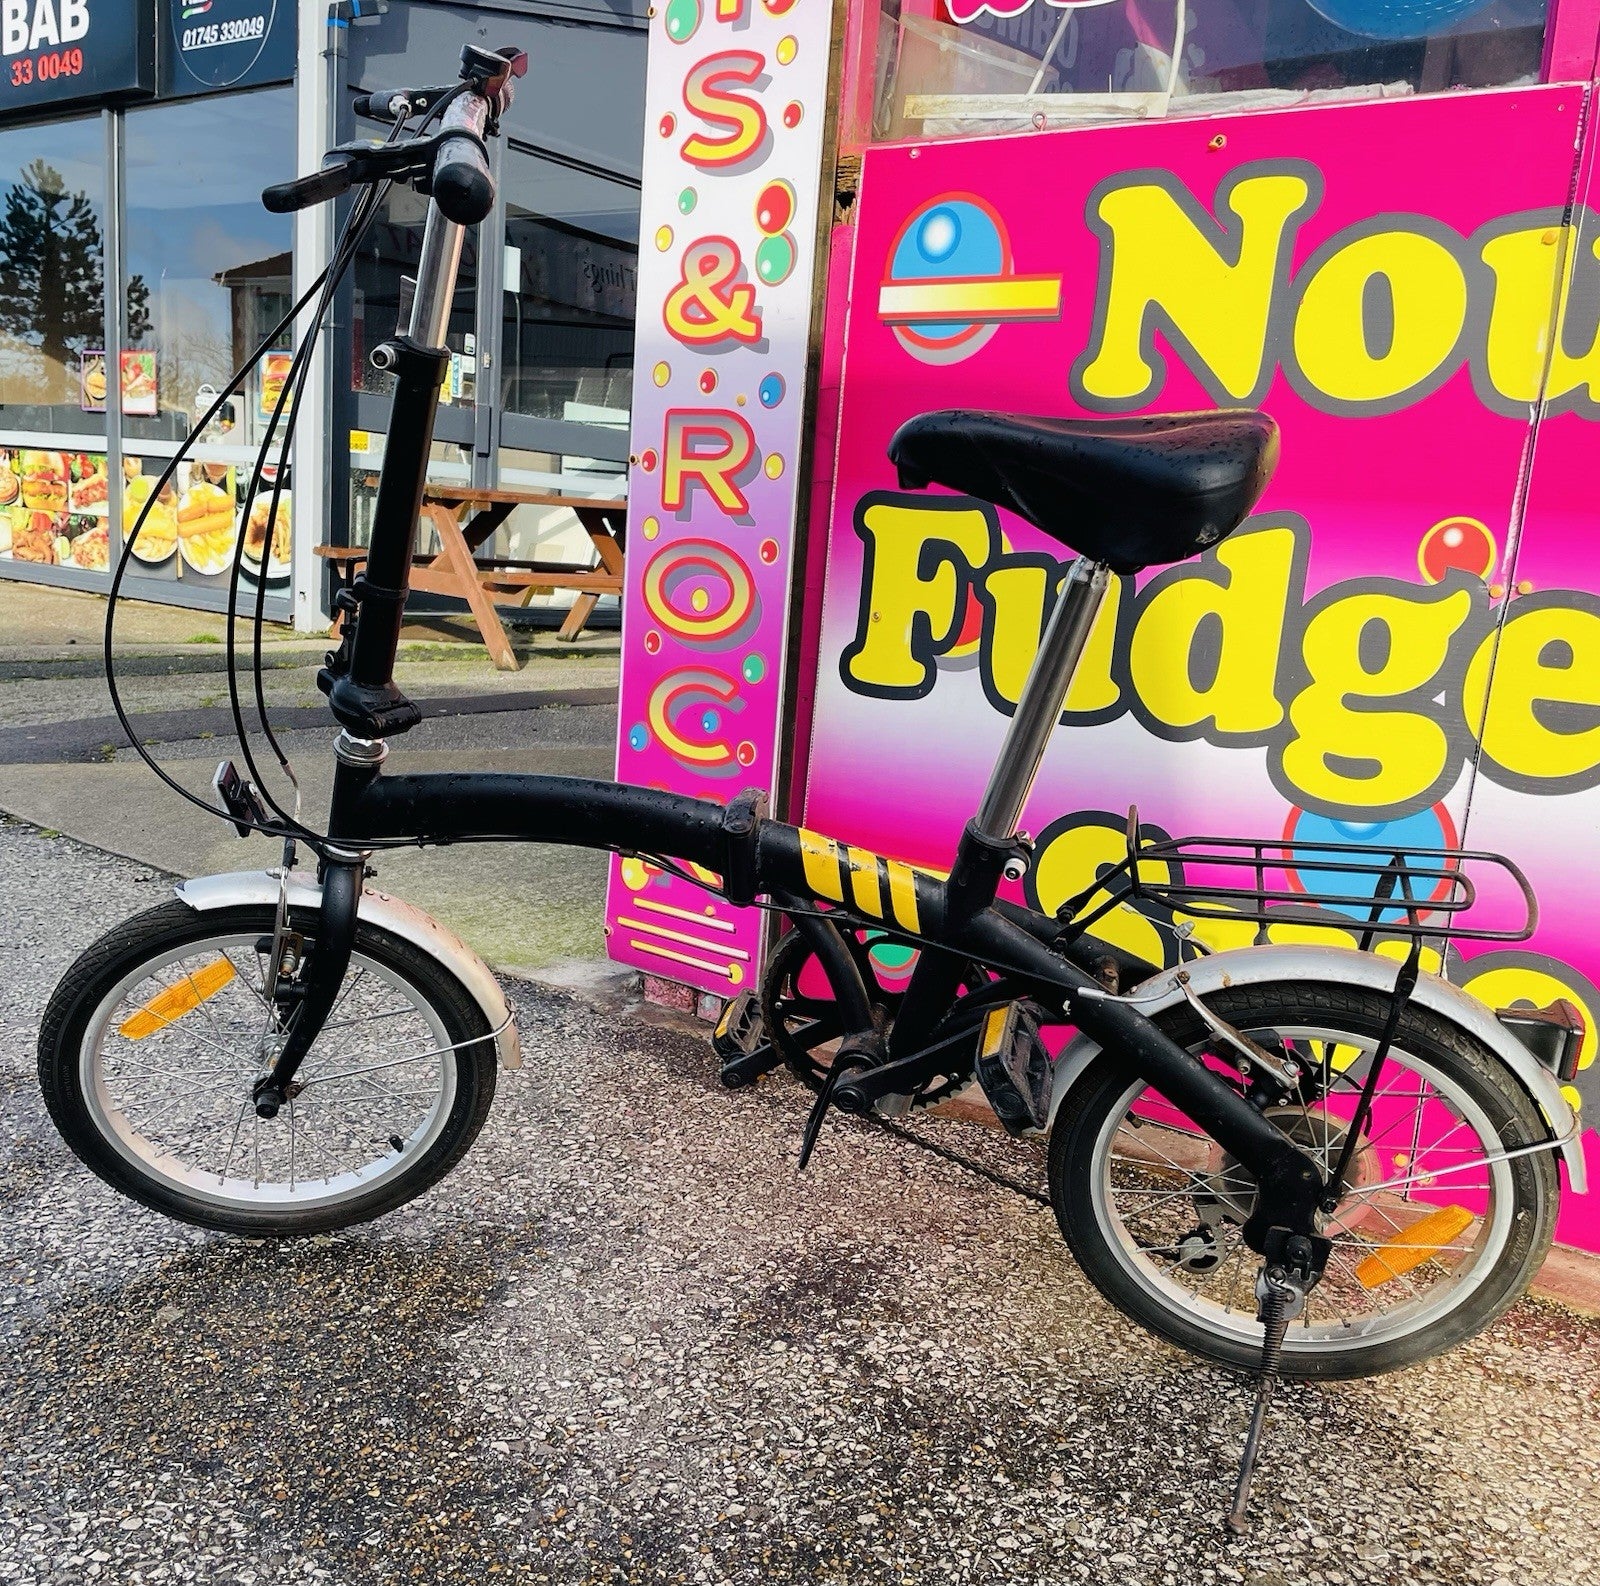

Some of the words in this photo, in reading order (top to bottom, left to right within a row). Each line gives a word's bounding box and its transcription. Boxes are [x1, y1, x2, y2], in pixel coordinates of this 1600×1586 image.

[2, 0, 90, 56] BAB
[11, 59, 34, 87] 33
[37, 47, 84, 82] 0049
[181, 24, 218, 48] 01745
[220, 15, 265, 42] 330049
[680, 0, 768, 168] S
[662, 235, 762, 345] &
[642, 408, 758, 890] ROC
[842, 492, 1600, 818] Fudge
